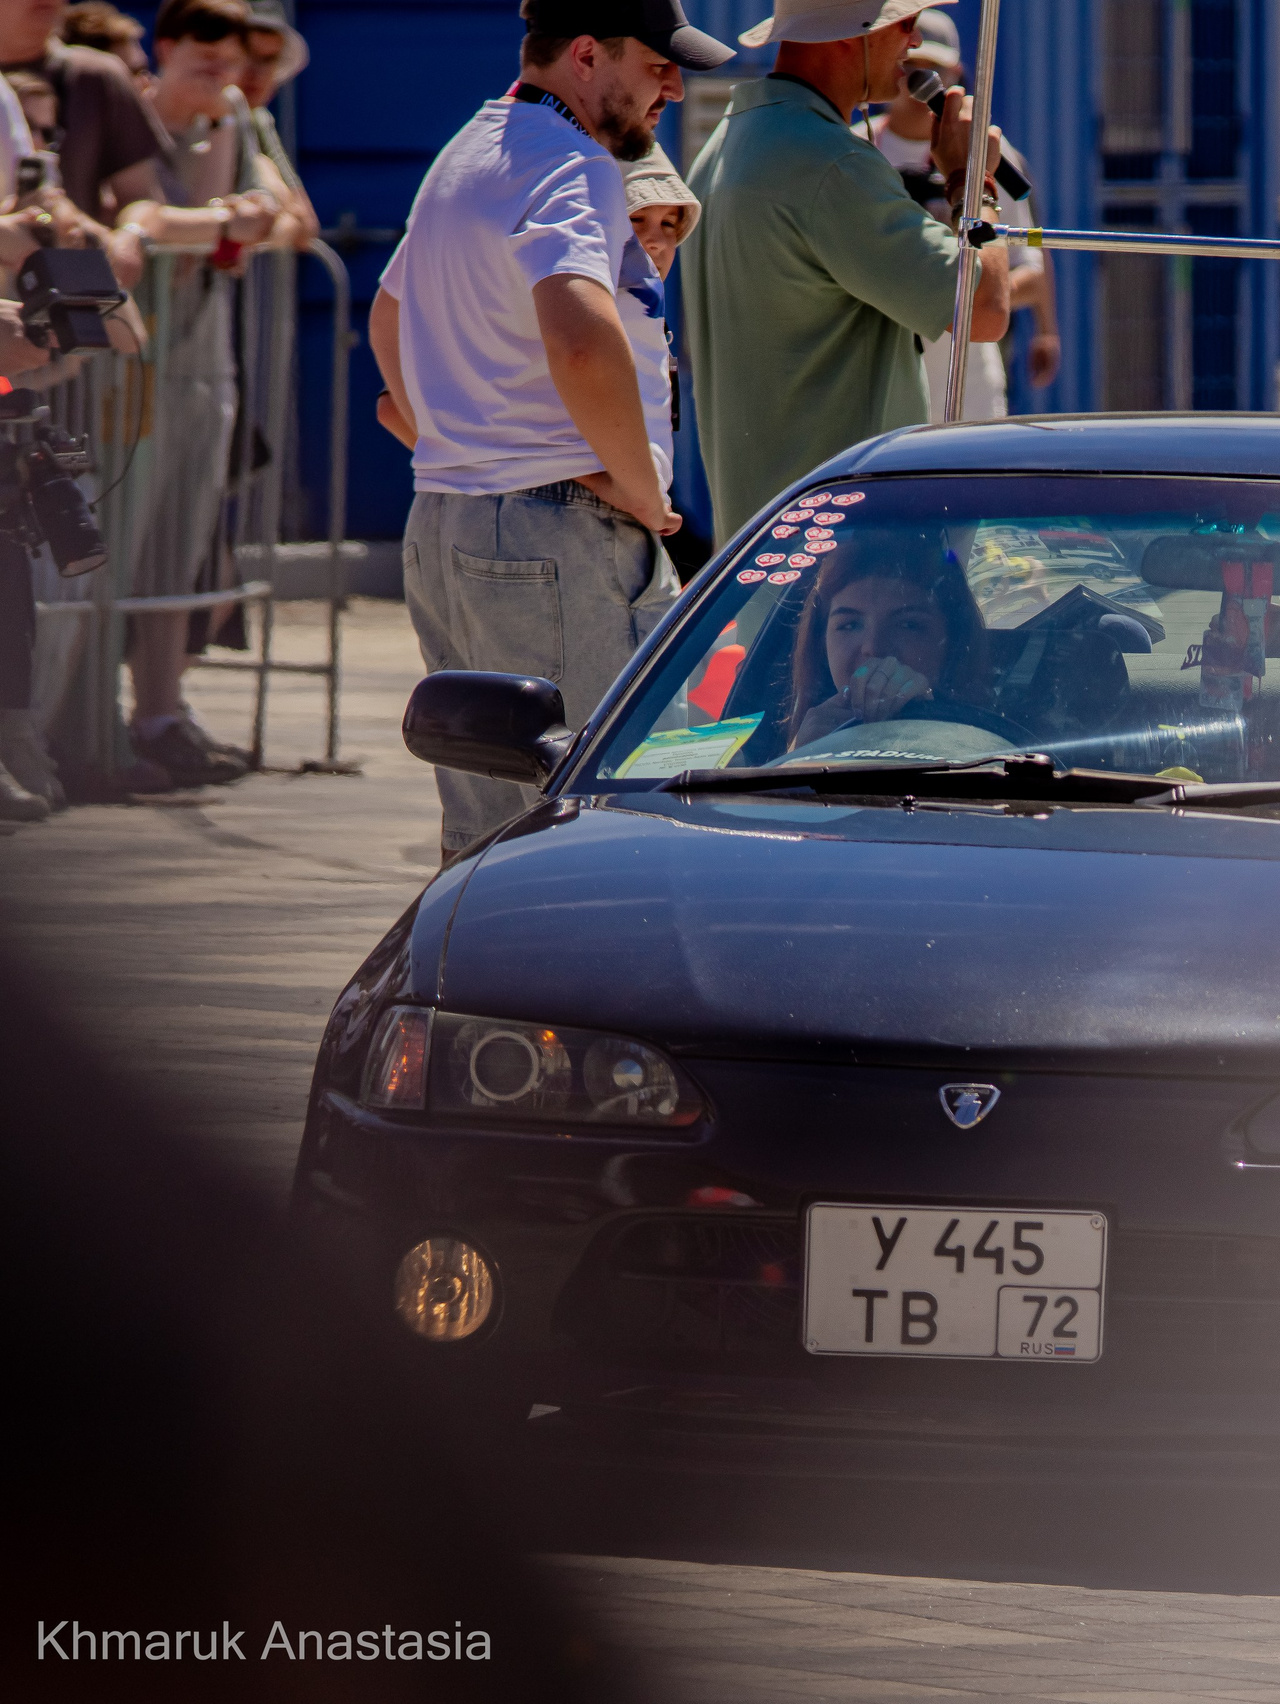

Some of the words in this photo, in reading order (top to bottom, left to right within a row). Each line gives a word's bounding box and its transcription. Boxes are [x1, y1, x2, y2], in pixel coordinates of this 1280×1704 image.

[872, 1216, 908, 1271] У
[934, 1218, 1045, 1275] 445
[852, 1288, 939, 1345] ТВ
[1022, 1295, 1079, 1339] 72
[1020, 1342, 1054, 1355] RUS
